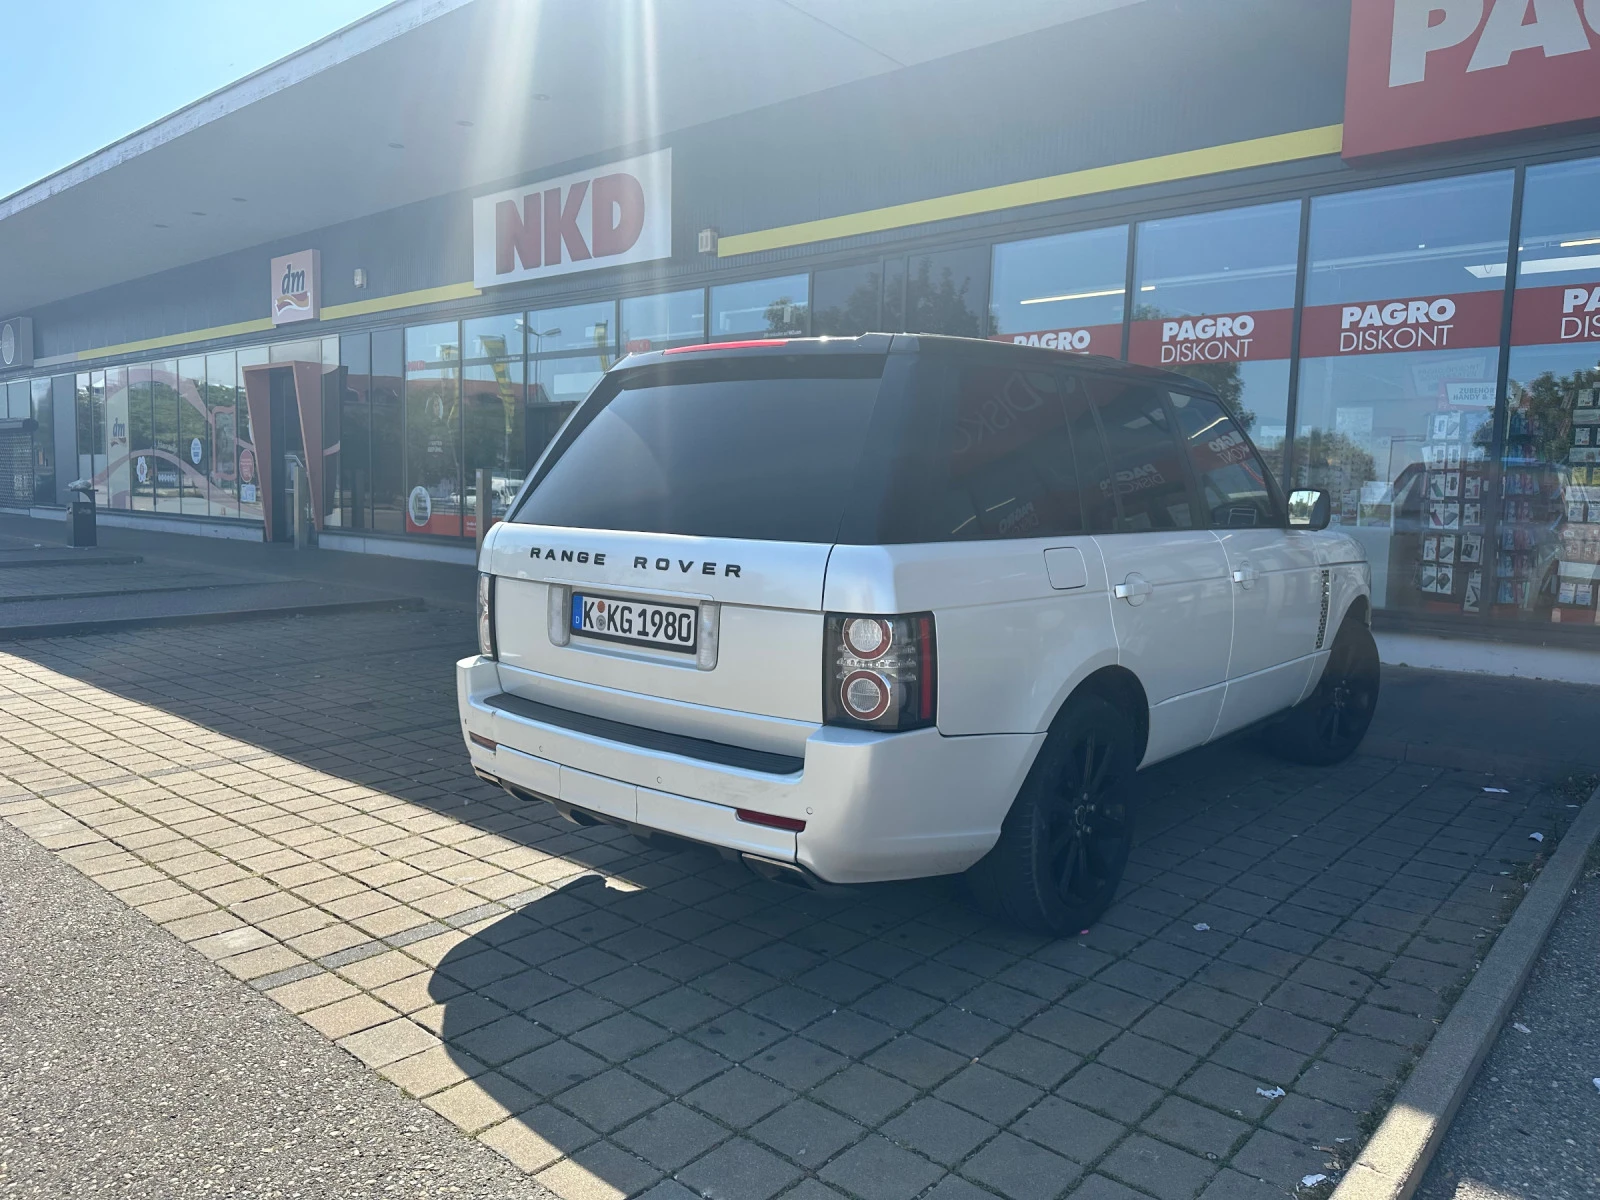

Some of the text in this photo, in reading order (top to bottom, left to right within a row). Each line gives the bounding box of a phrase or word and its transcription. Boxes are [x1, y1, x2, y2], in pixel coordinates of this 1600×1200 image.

[1389, 0, 1600, 88] PA
[495, 172, 646, 275] NKD
[281, 262, 306, 295] dm
[1341, 298, 1456, 329] PAGRO
[1162, 315, 1255, 343] PAGRO
[1339, 324, 1454, 352] DISKONT
[1160, 338, 1254, 364] DISKONT
[1453, 393, 1480, 401] HANDY
[530, 547, 742, 578] RANGE ROVER
[582, 600, 595, 630] K
